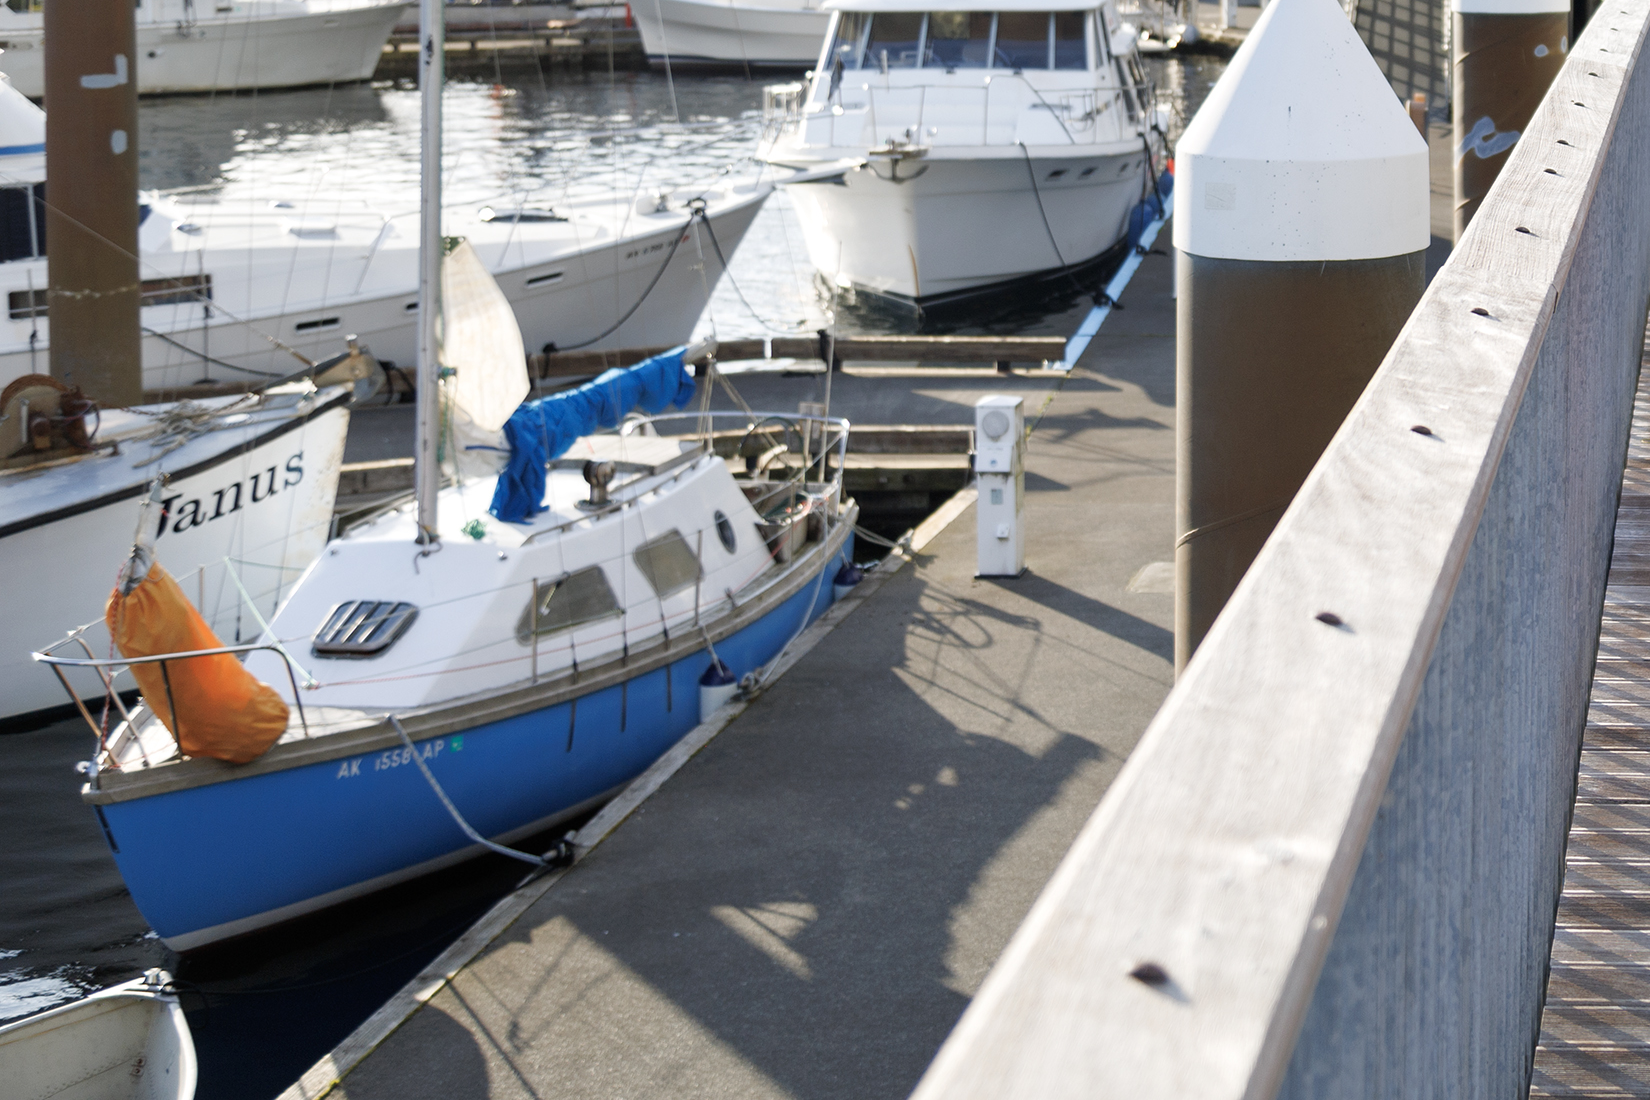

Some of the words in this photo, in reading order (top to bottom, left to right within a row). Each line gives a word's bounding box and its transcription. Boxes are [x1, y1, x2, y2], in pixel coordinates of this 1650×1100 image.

[155, 450, 304, 541] Janus
[336, 758, 363, 780] AK
[423, 739, 445, 760] AP
